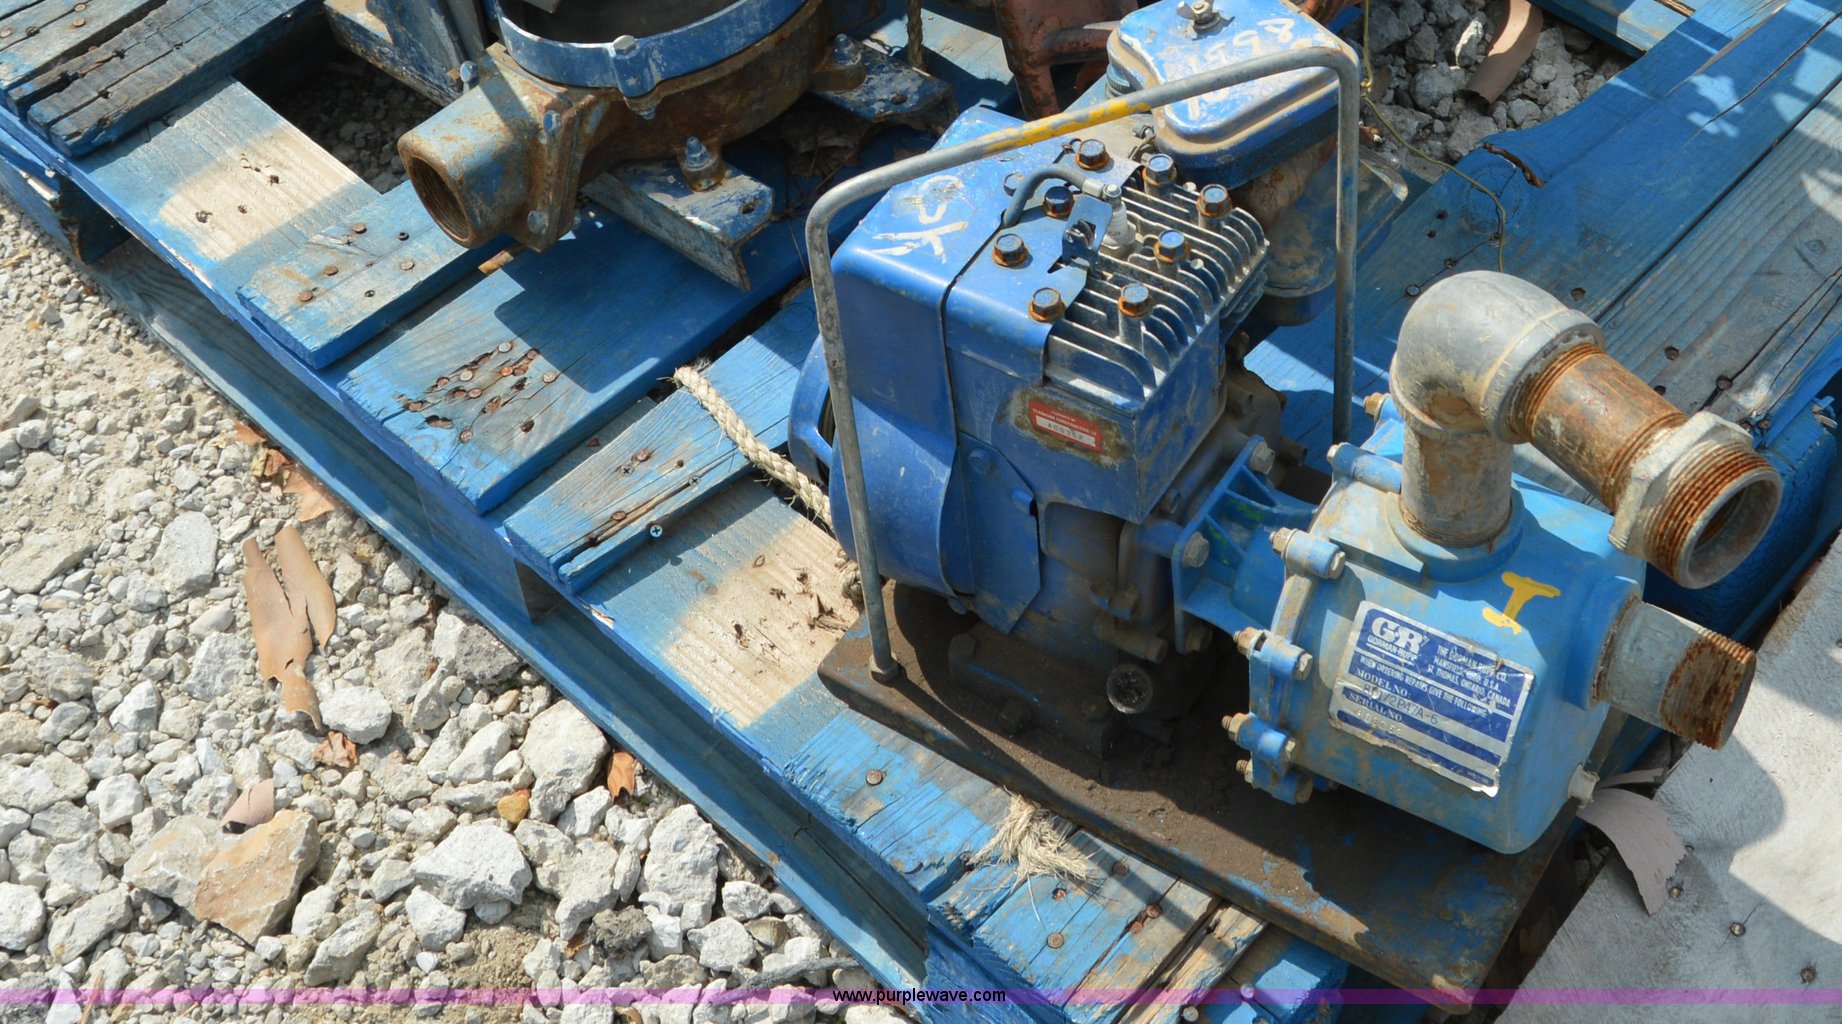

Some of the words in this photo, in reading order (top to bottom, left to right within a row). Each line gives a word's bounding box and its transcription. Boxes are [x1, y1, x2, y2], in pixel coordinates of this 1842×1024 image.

[1437, 644, 1449, 658] THE
[1354, 667, 1391, 691] MODEL
[1360, 655, 1376, 670] WHEN
[1376, 663, 1405, 682] ORDERING
[1349, 692, 1387, 716] SERIAL
[1487, 690, 1511, 708] CANADA
